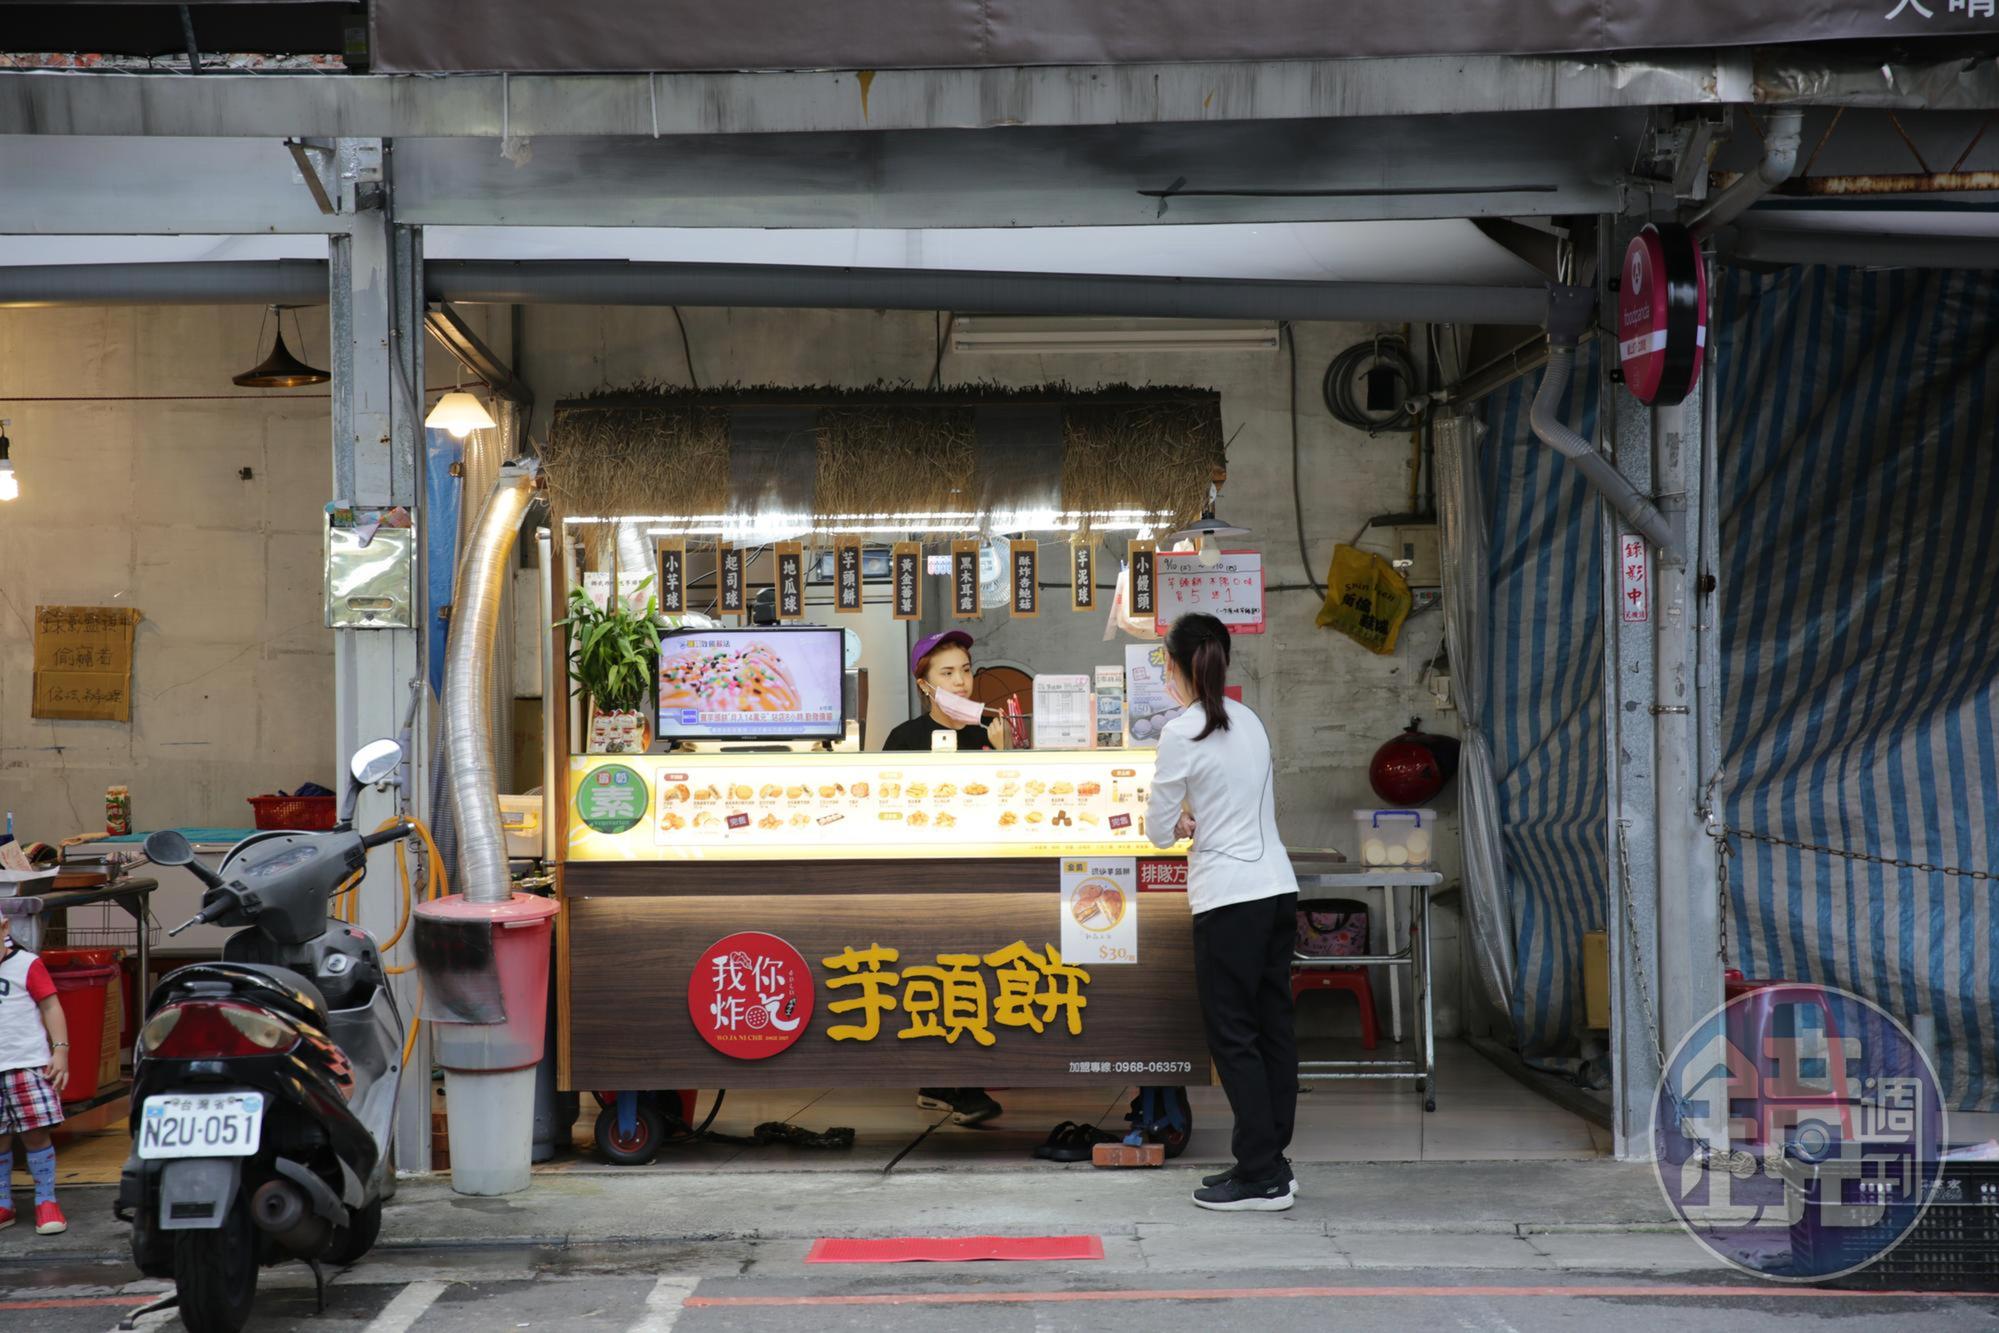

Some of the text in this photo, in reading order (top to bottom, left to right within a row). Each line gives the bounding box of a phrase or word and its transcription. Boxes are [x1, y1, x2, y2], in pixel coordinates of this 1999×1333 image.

[1624, 305, 1650, 328] foodpanda
[666, 556, 679, 609] 小芋球
[725, 554, 738, 608] 起司球
[783, 560, 797, 612] 地瓜球
[842, 552, 855, 605] 芋頭餅
[901, 558, 913, 612] 黃金蕃薯
[961, 557, 973, 610] 黑木耳露
[1018, 556, 1031, 609] 酥炸杏鮑菇
[1078, 550, 1088, 604] 芋泥球
[1136, 557, 1149, 609] 小饅頭
[1192, 588, 1200, 603] 5
[1625, 542, 1643, 605] 錄影中
[822, 940, 1090, 1046] 芋頭餅
[181, 1098, 225, 1111] 台灣省
